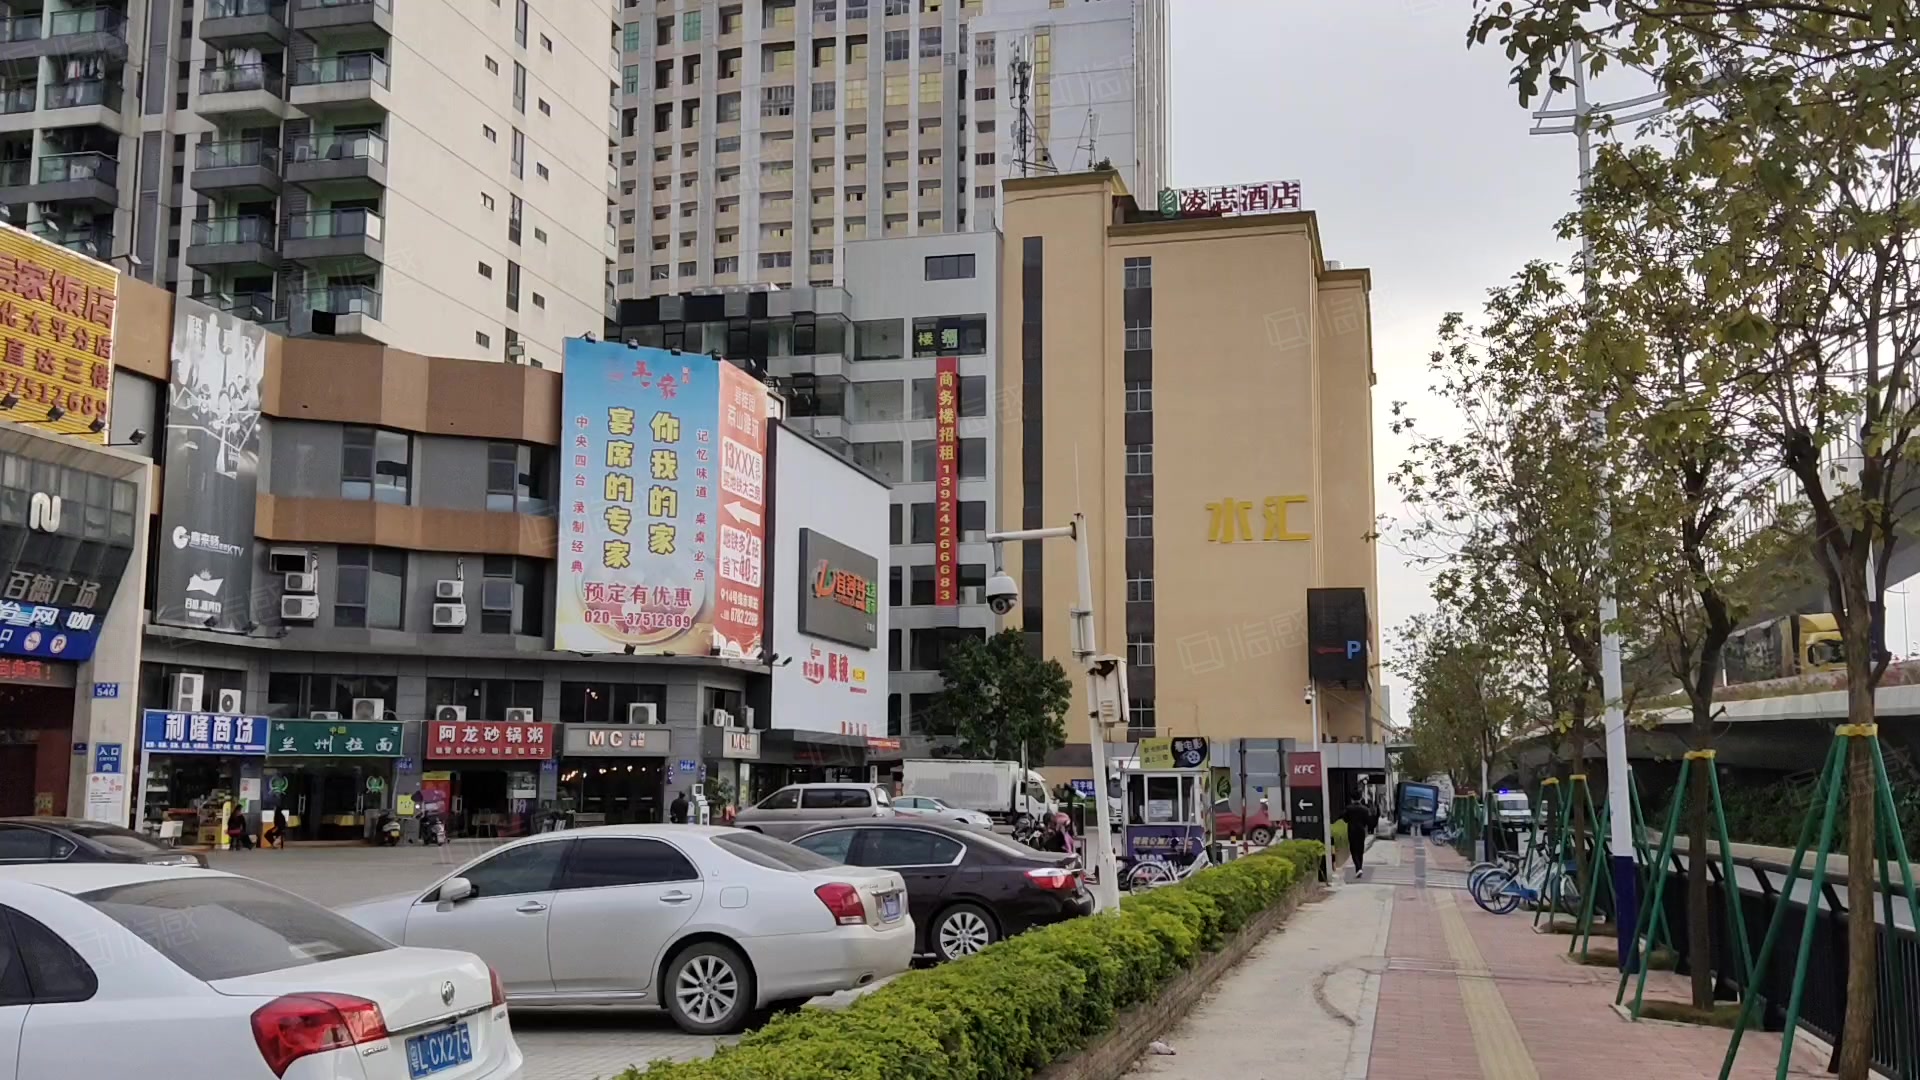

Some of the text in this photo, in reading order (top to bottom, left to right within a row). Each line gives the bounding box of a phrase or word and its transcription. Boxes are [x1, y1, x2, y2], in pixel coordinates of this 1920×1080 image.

[1181, 181, 1300, 213] 凌志酒店
[571, 415, 589, 574] 中央四台 录制经典
[604, 406, 635, 570] 宴席的专家
[648, 411, 680, 556] 你我的家
[693, 428, 709, 581] 记忆味道 桌桌必点
[1205, 494, 1312, 543] 水汇
[4, 570, 101, 610] 百德广场
[584, 582, 692, 607] 预定有优惠
[1346, 640, 1361, 660] P
[96, 687, 116, 697] 546
[165, 714, 254, 744] 利隆商场
[439, 725, 544, 744] 阿龙砂锅粥
[589, 730, 623, 748] MC
[98, 746, 119, 756] 入口
[278, 735, 393, 754] 兰州拉面
[1294, 764, 1316, 775] KFC
